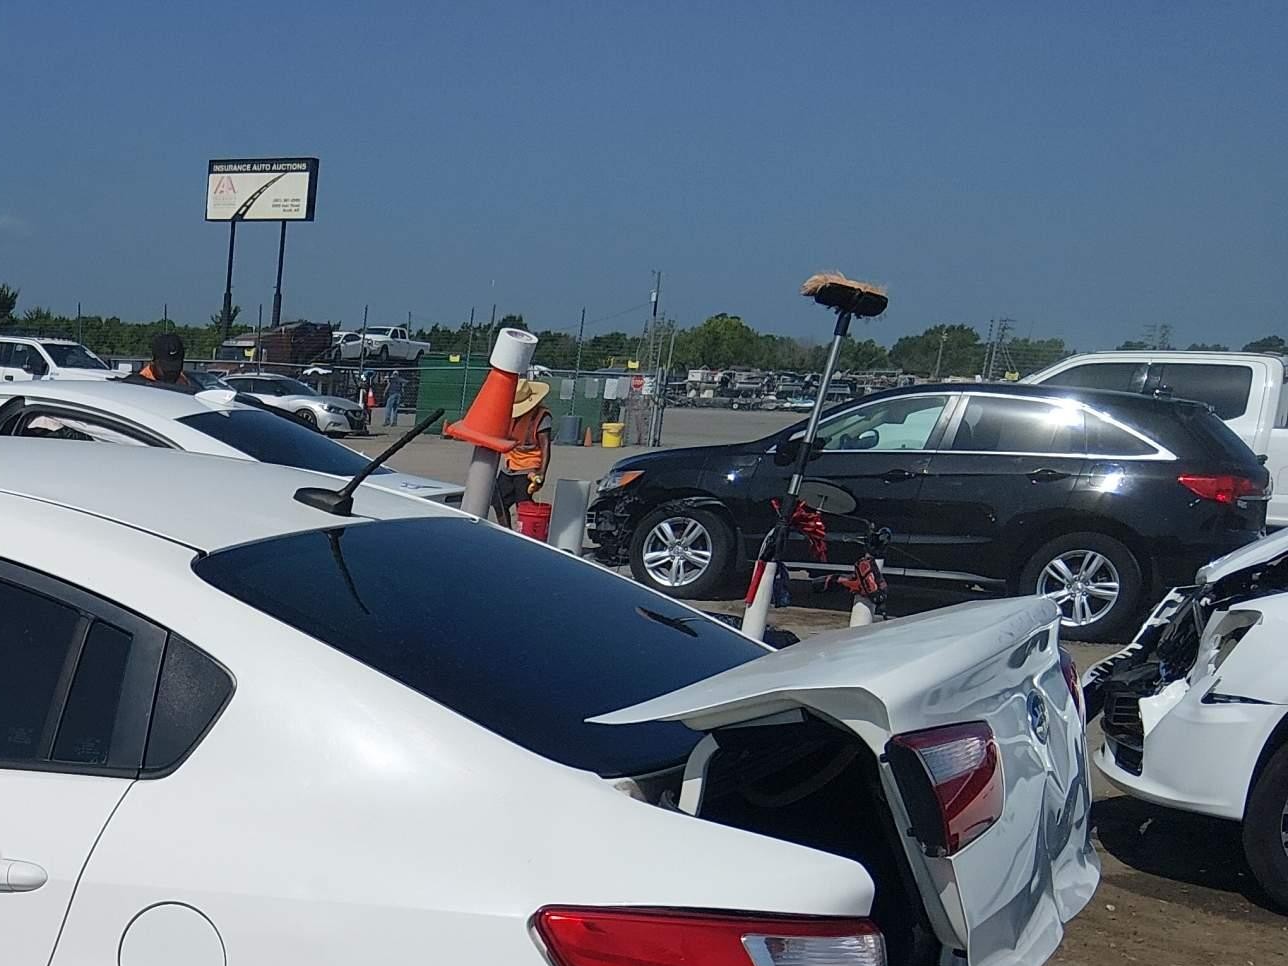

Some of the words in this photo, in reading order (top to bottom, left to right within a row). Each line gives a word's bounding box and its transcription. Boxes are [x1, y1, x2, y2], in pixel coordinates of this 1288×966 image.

[213, 164, 251, 172] INSURANCE
[252, 163, 271, 171] AUTO
[272, 163, 307, 171] AUCTIONS
